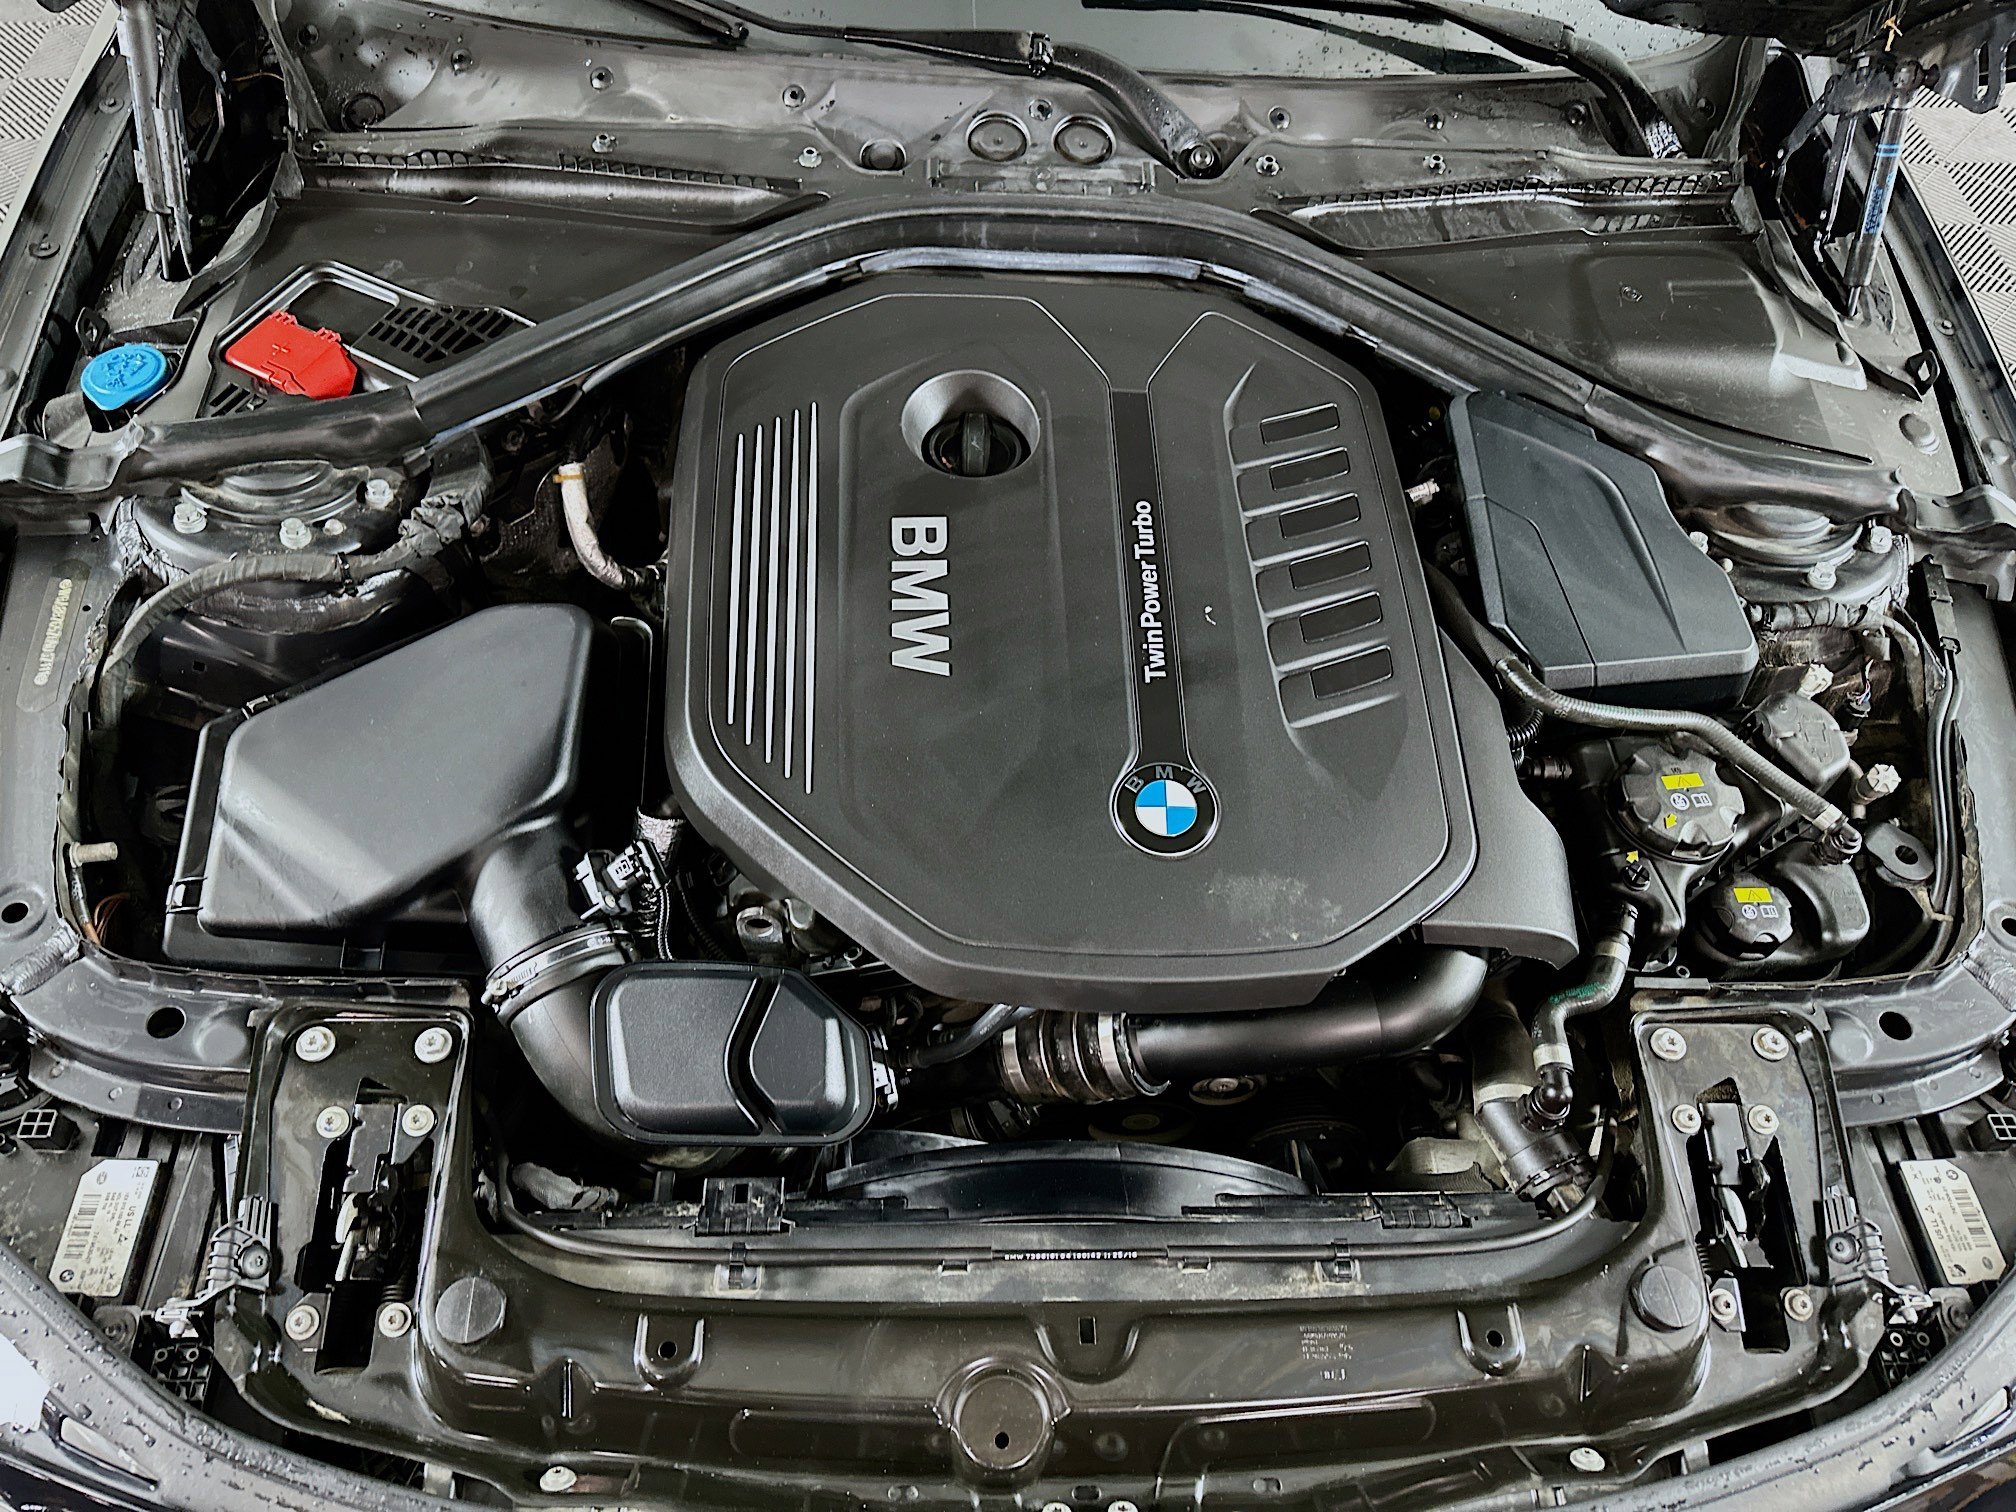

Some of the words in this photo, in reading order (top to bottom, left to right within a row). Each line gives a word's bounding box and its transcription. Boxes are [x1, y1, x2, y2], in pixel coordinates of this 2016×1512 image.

[1131, 500, 1156, 560] Turbo
[891, 516, 950, 677] BMW
[1140, 560, 1167, 684] TwinPower
[1124, 765, 1207, 794] BMW
[1004, 1253, 1024, 1261] BMW
